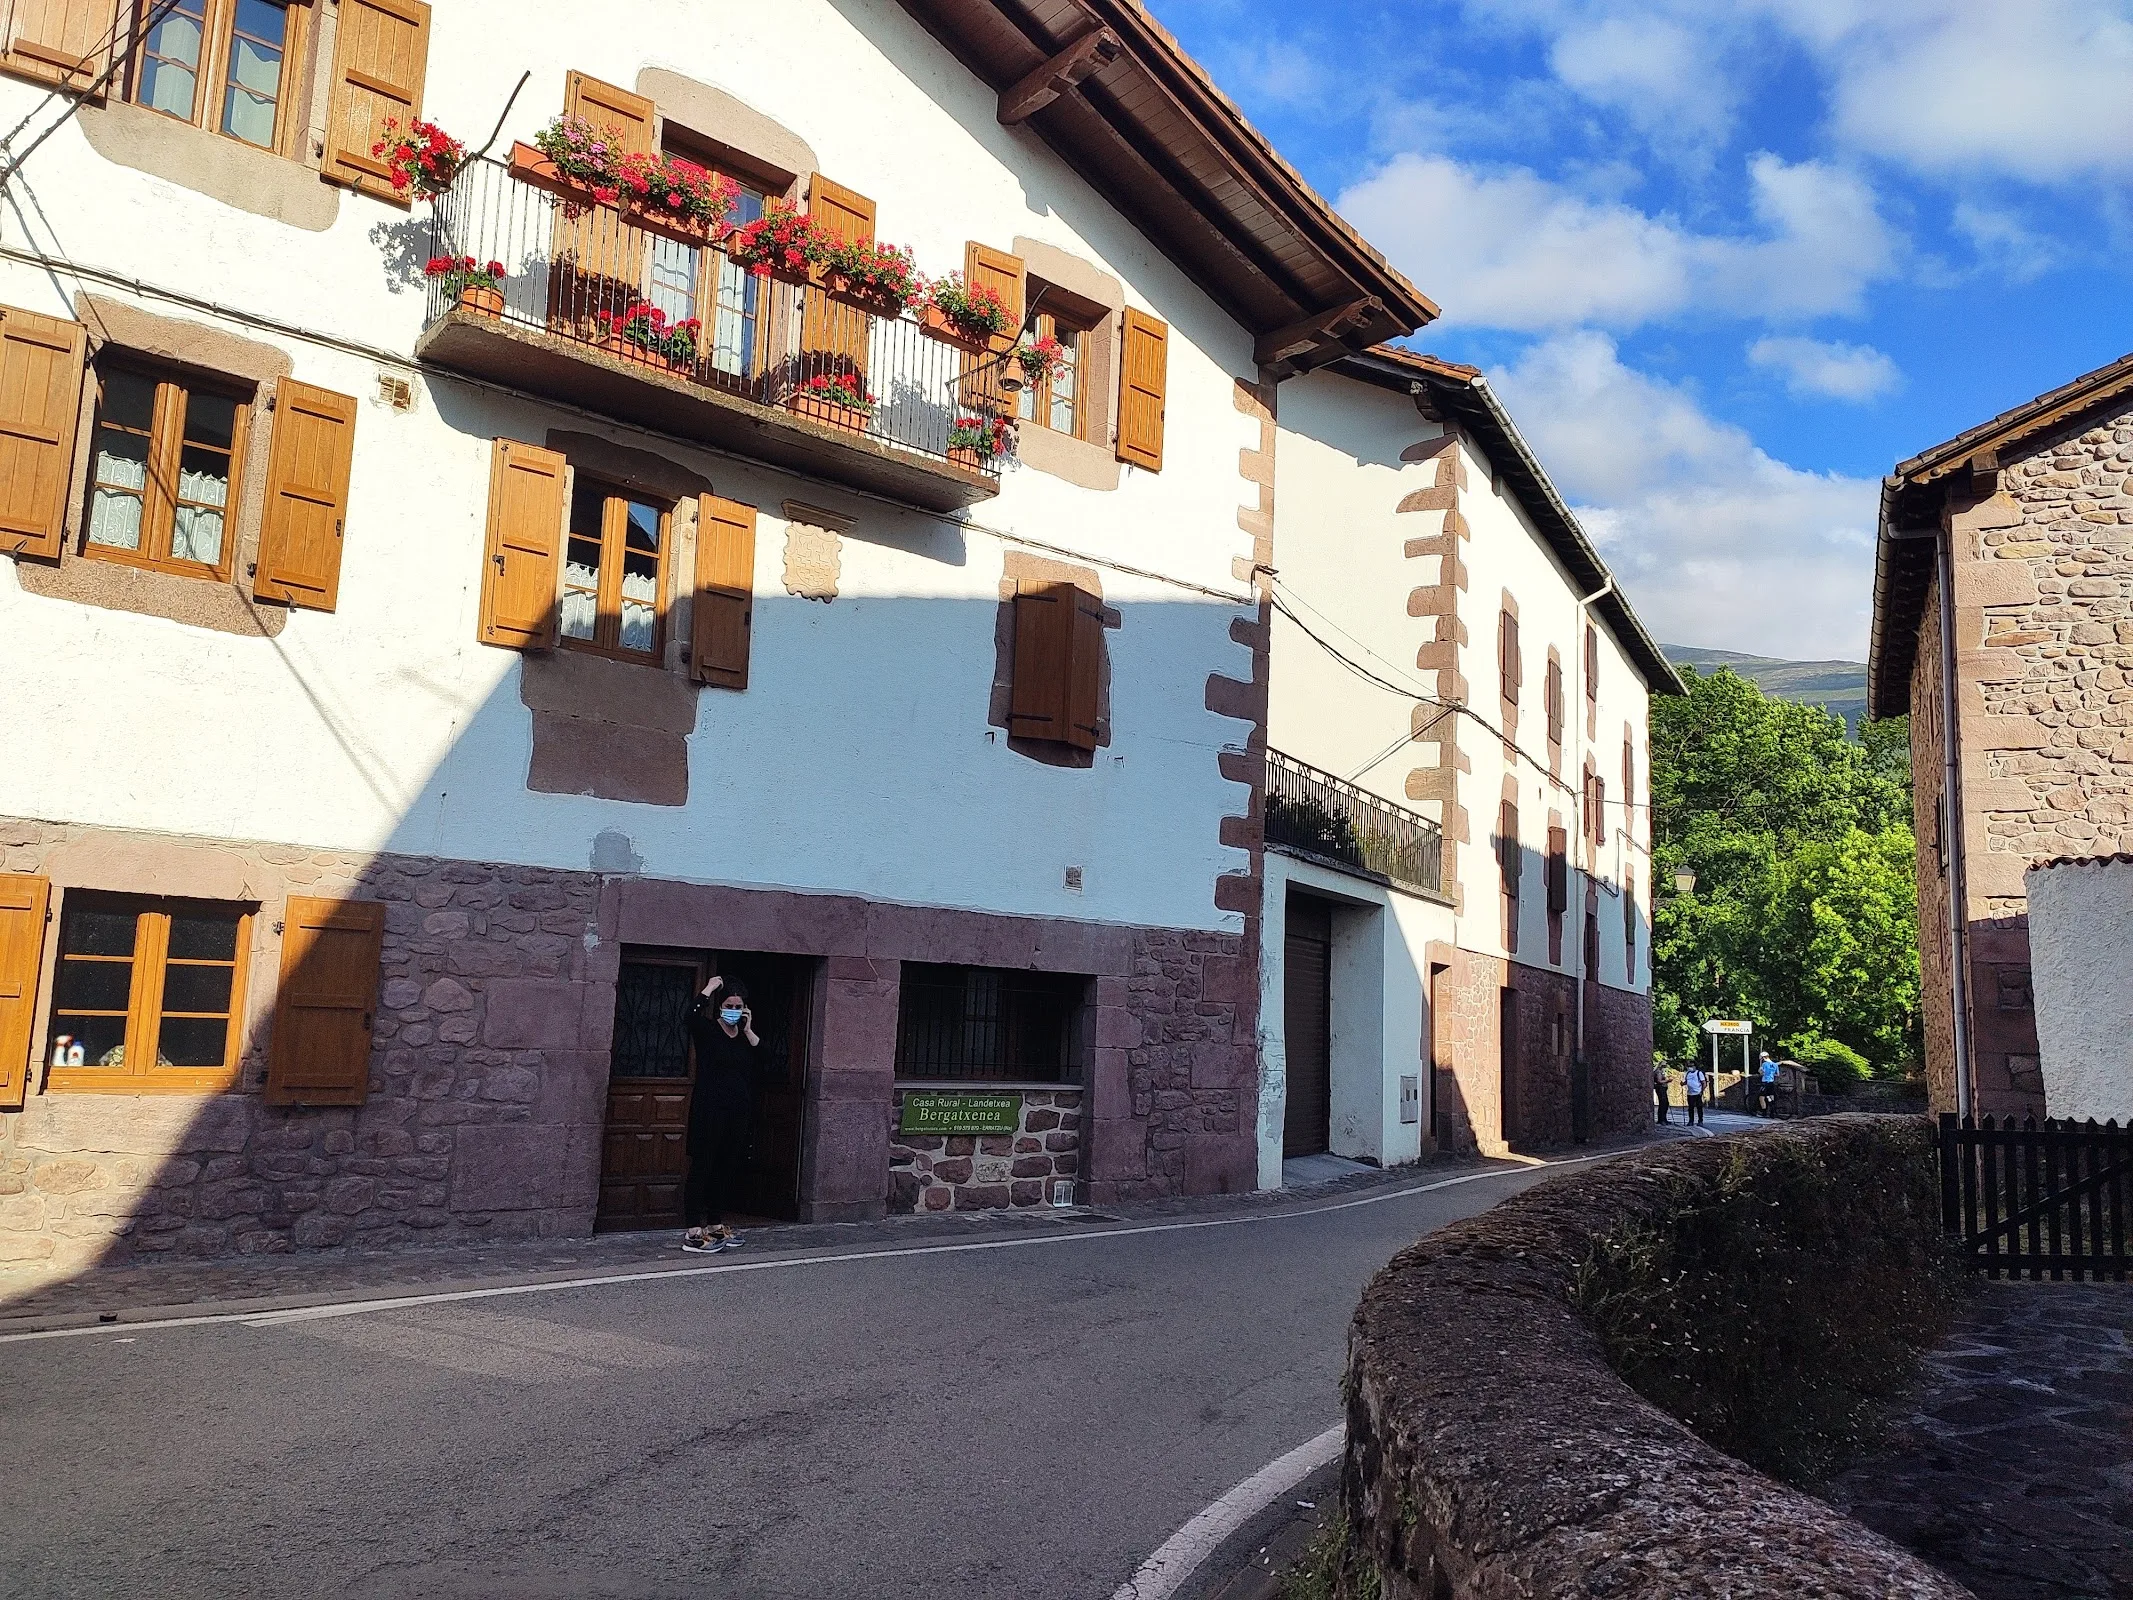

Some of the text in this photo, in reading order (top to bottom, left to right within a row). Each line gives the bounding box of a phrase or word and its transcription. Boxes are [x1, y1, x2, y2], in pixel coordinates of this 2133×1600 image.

[912, 1097, 935, 1107] Casa
[937, 1098, 960, 1107] Rural
[968, 1098, 1011, 1108] Landetxea
[919, 1107, 1001, 1124] Bergatxenea
